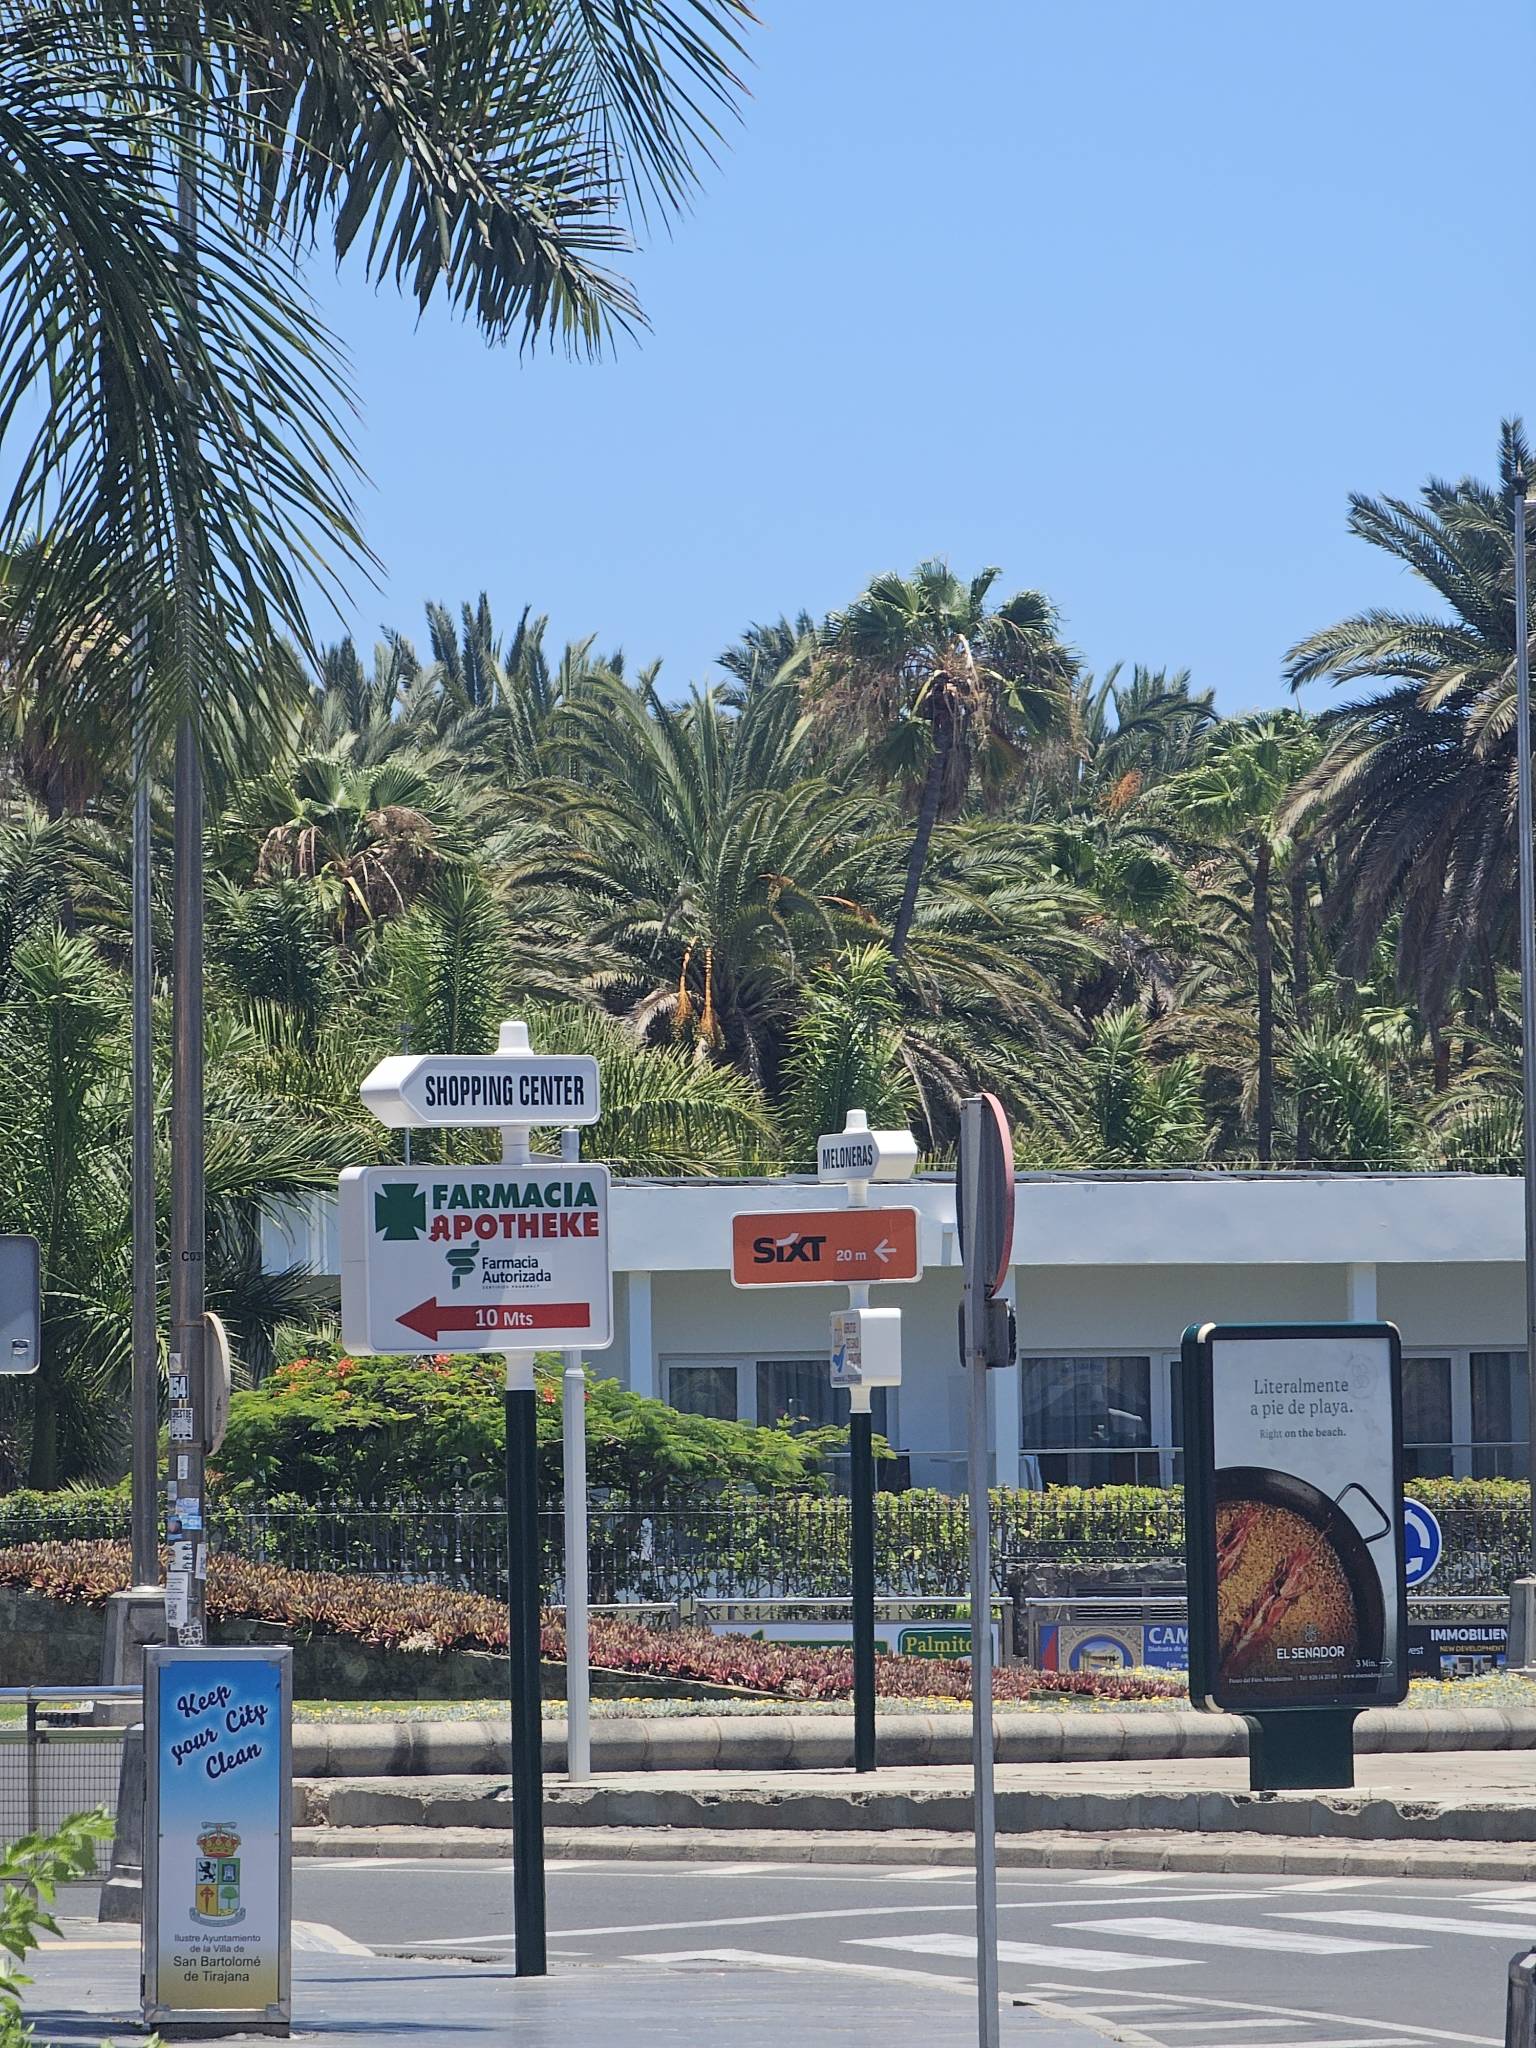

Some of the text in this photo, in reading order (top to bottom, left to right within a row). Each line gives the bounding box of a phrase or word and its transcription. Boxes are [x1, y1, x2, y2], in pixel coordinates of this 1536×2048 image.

[426, 1075, 585, 1106] SHOPPING CENTER
[822, 1144, 873, 1170] MELONERAS
[433, 1182, 598, 1210] FARMACIA
[428, 1211, 599, 1242] APOTHEKE
[482, 1255, 539, 1270] Farmacia
[836, 1249, 852, 1261] 20
[855, 1251, 867, 1261] m
[482, 1269, 552, 1284] Autorizada
[475, 1308, 534, 1327] 10 Mts
[1254, 1377, 1349, 1394] Literalmente
[1250, 1398, 1353, 1419] a pie de playa.
[1260, 1426, 1347, 1440] Right on the beach.
[1276, 1645, 1345, 1660] EL SENADOR
[1455, 1644, 1505, 1652] DEVELOPMENT
[177, 1685, 231, 1718] Keep
[171, 1704, 268, 1766] your City
[206, 1743, 262, 1779] Clean
[174, 1934, 261, 1944] Ilustre Ayuntamiento
[189, 1944, 245, 1953] de la Villa de
[173, 1955, 261, 1967] San Bartolomé
[183, 1970, 250, 1984] de Tirajana
